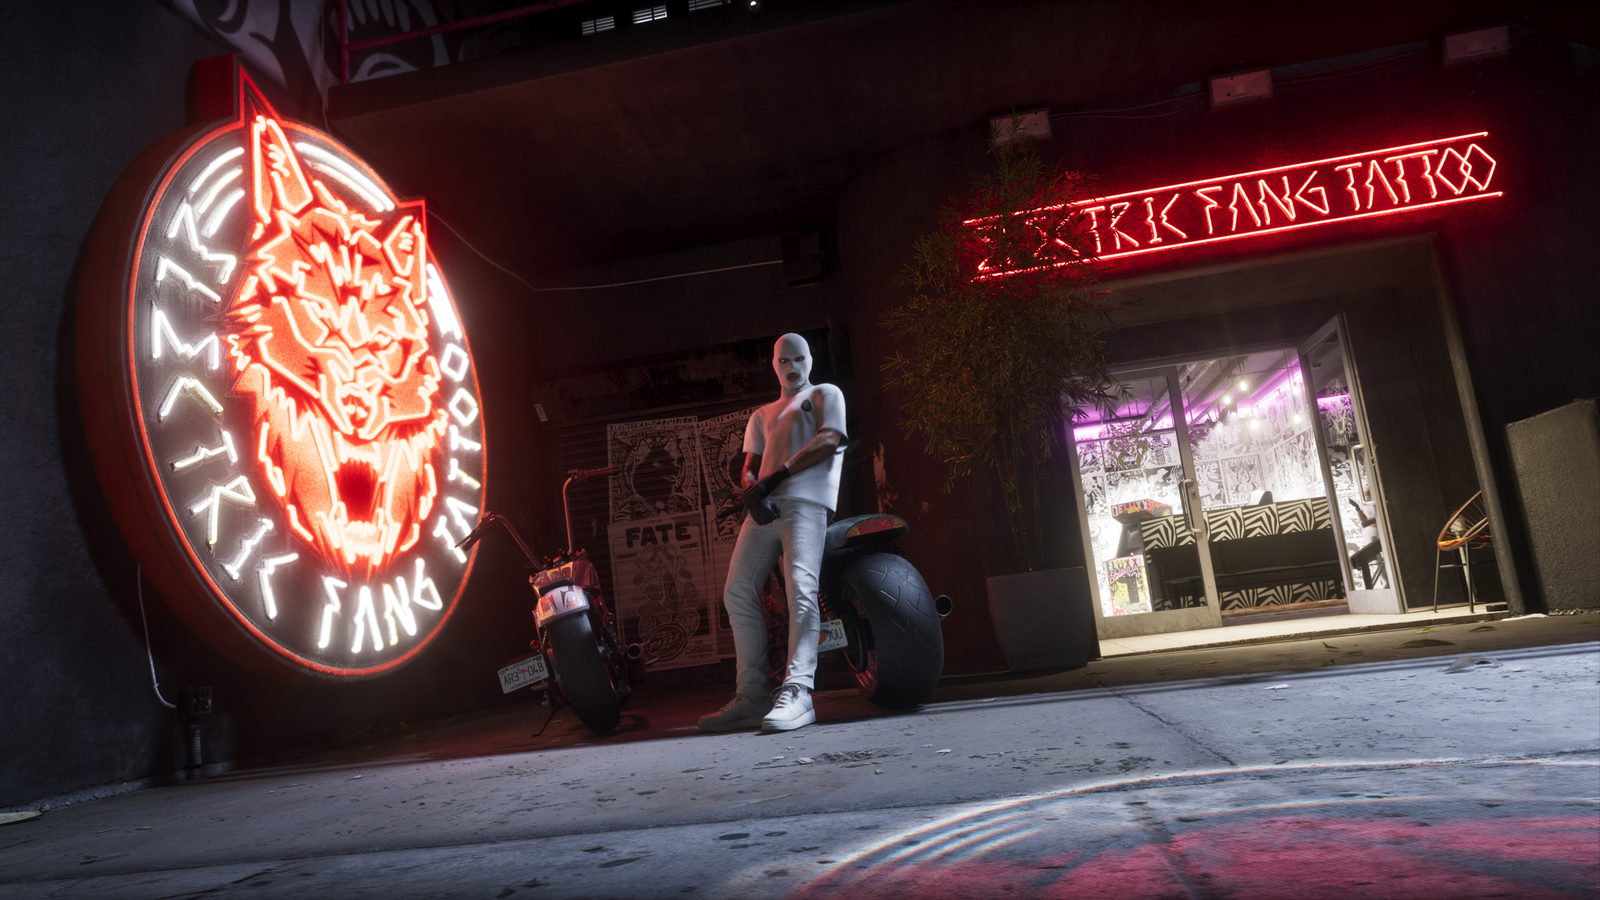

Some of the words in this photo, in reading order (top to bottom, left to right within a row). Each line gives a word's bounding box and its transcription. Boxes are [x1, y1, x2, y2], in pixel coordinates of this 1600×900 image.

[975, 193, 1188, 272] EECTRIC
[1195, 169, 1330, 236] FANG
[1334, 143, 1497, 212] TATTOO
[625, 520, 692, 549] FATE
[317, 557, 443, 653] FANG
